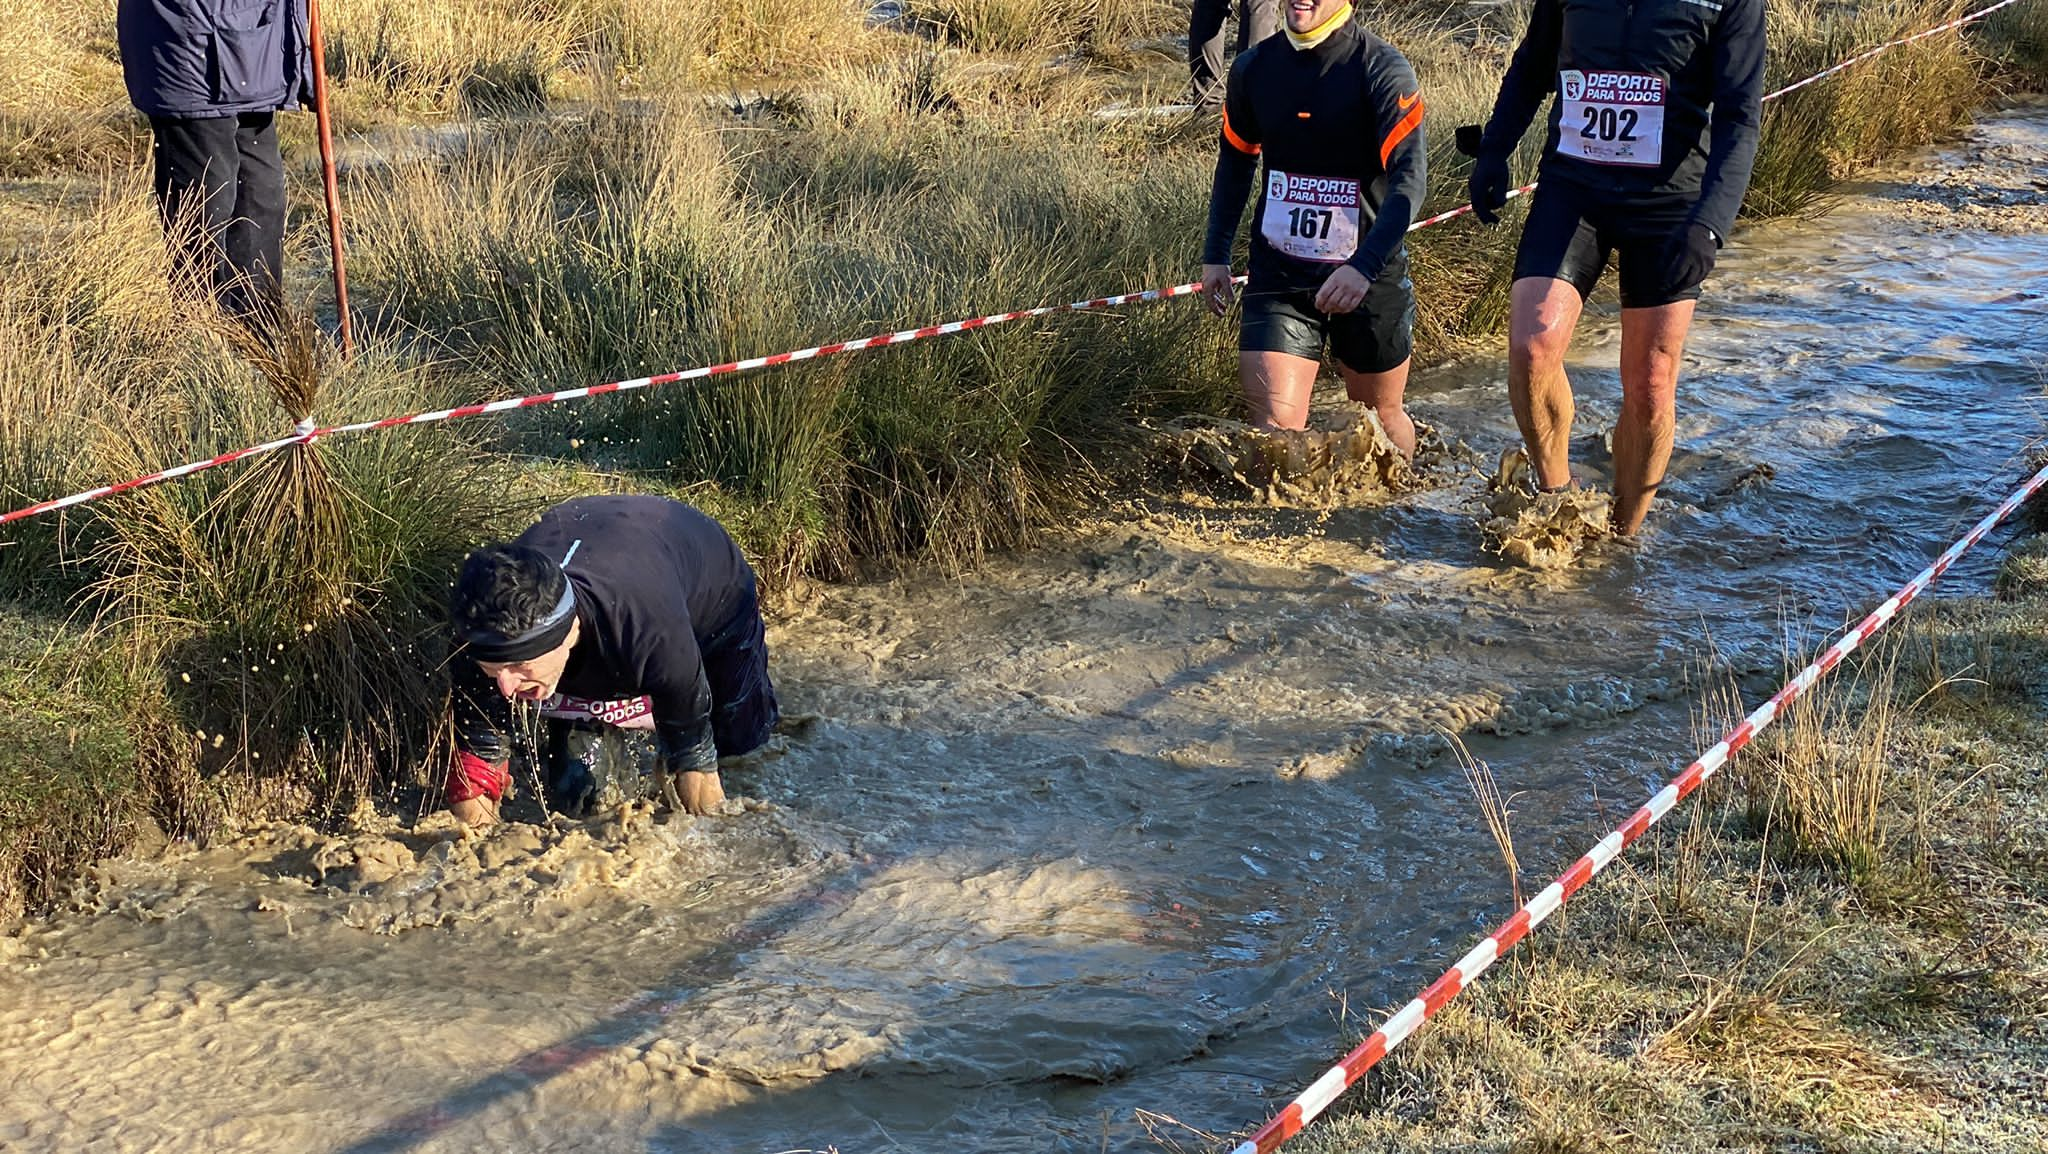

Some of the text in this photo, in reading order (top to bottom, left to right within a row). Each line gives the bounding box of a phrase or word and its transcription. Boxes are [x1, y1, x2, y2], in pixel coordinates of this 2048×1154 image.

[1587, 73, 1662, 90] DEPORTE
[1586, 89, 1661, 102] PARA TODOS
[1580, 106, 1638, 141] 202
[1289, 176, 1357, 194] DEPORTE
[1289, 190, 1356, 205] PARA TODOS
[1288, 207, 1333, 239] 167
